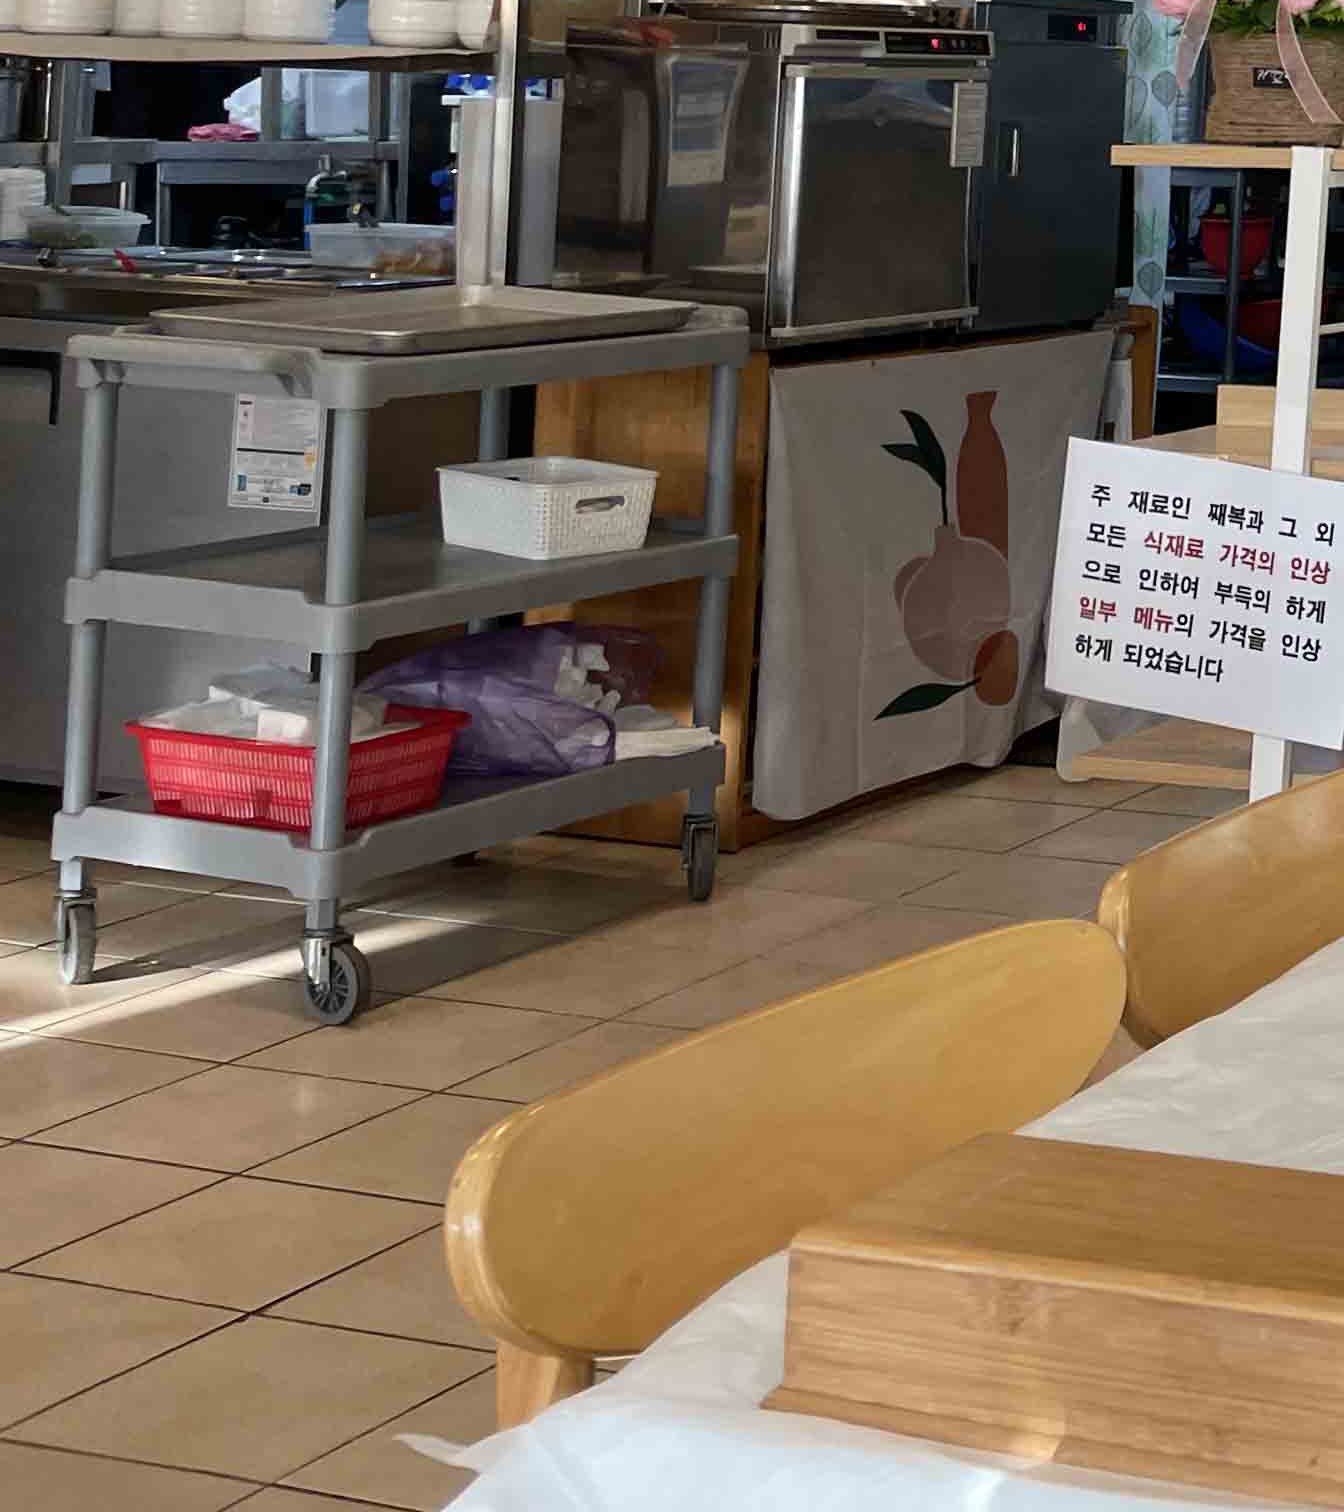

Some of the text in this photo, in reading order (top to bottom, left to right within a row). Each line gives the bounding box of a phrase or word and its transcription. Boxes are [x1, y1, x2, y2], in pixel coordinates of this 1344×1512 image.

[1091, 485, 1335, 546] 주 재료인 째복과 그 외
[1086, 522, 1330, 585] 모든 식재료 가격의 인상
[1082, 560, 1122, 585] 으로
[1138, 568, 1199, 600] 인하여
[1286, 595, 1326, 624] 하게
[1075, 634, 1223, 683] 하게 되었습니다
[1079, 596, 1322, 662] 일부 메뉴의 가격을 인상
